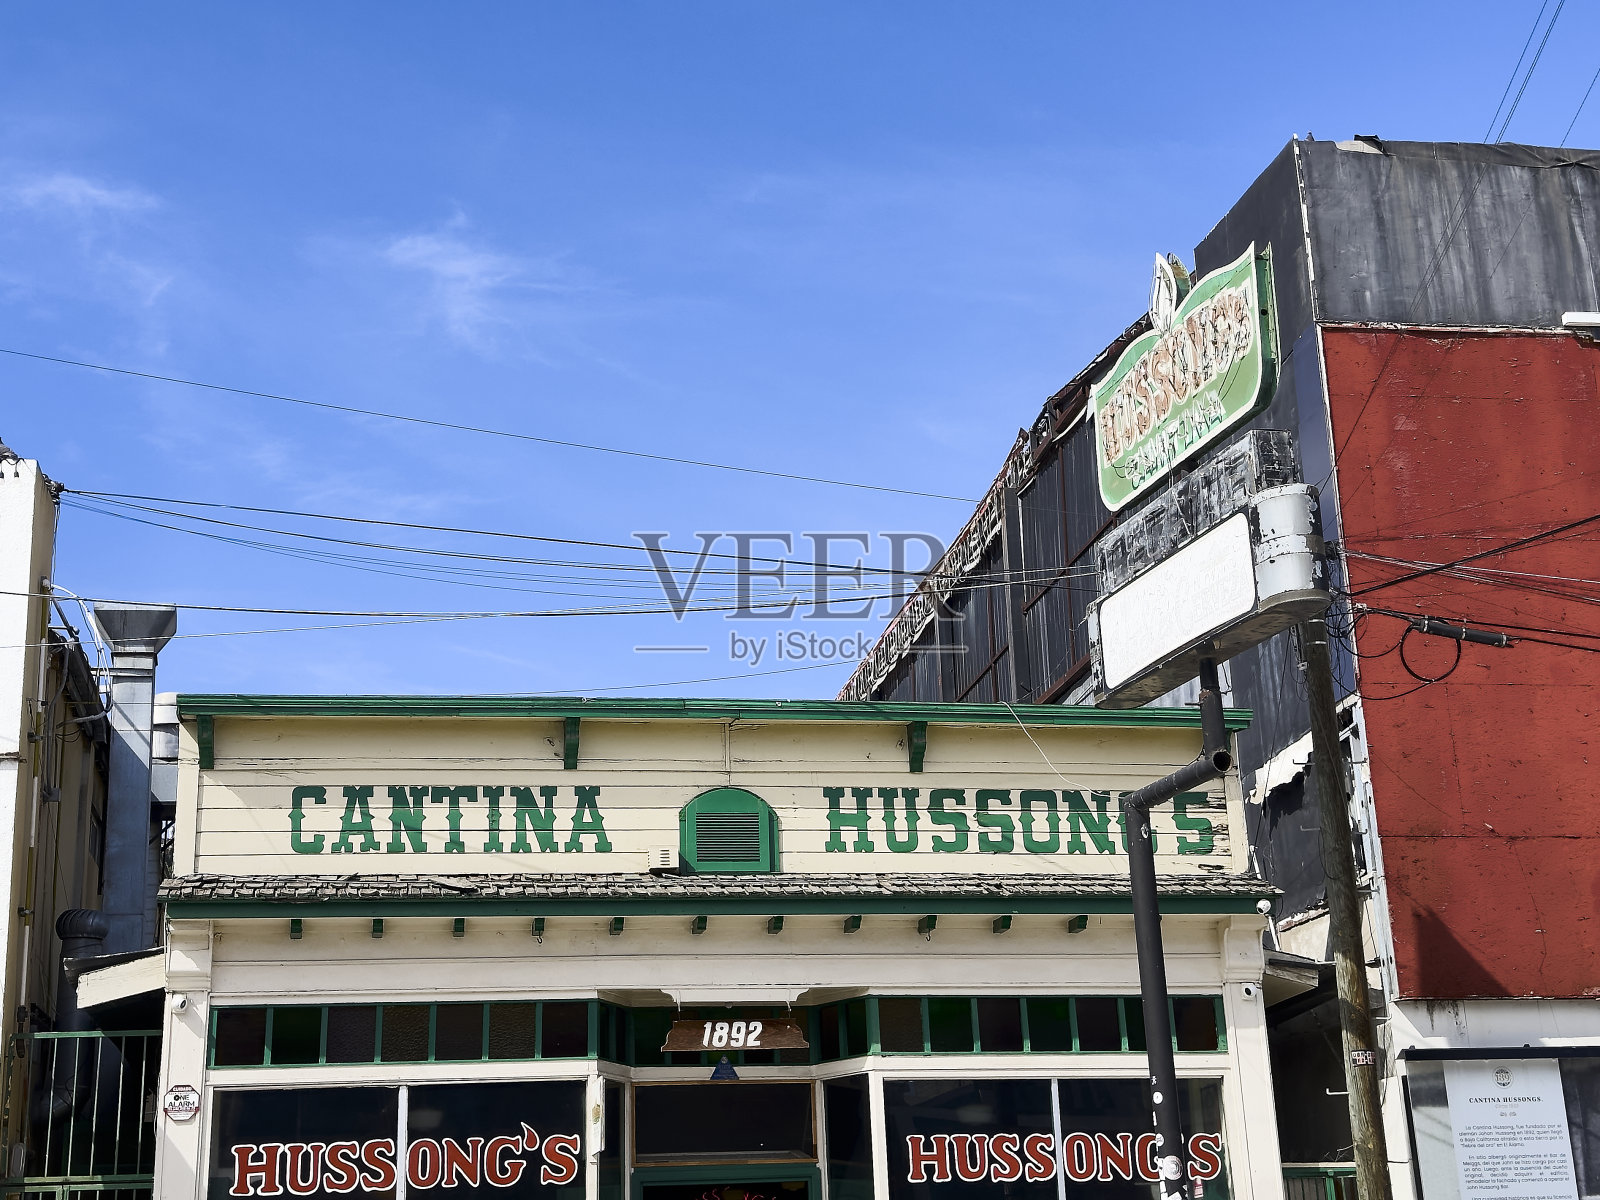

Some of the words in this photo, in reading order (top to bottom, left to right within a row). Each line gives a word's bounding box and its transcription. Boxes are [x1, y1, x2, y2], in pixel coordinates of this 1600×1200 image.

[288, 786, 612, 854] CANTINA
[702, 1021, 763, 1048] 1892
[229, 1121, 581, 1197] HUSSONG'S
